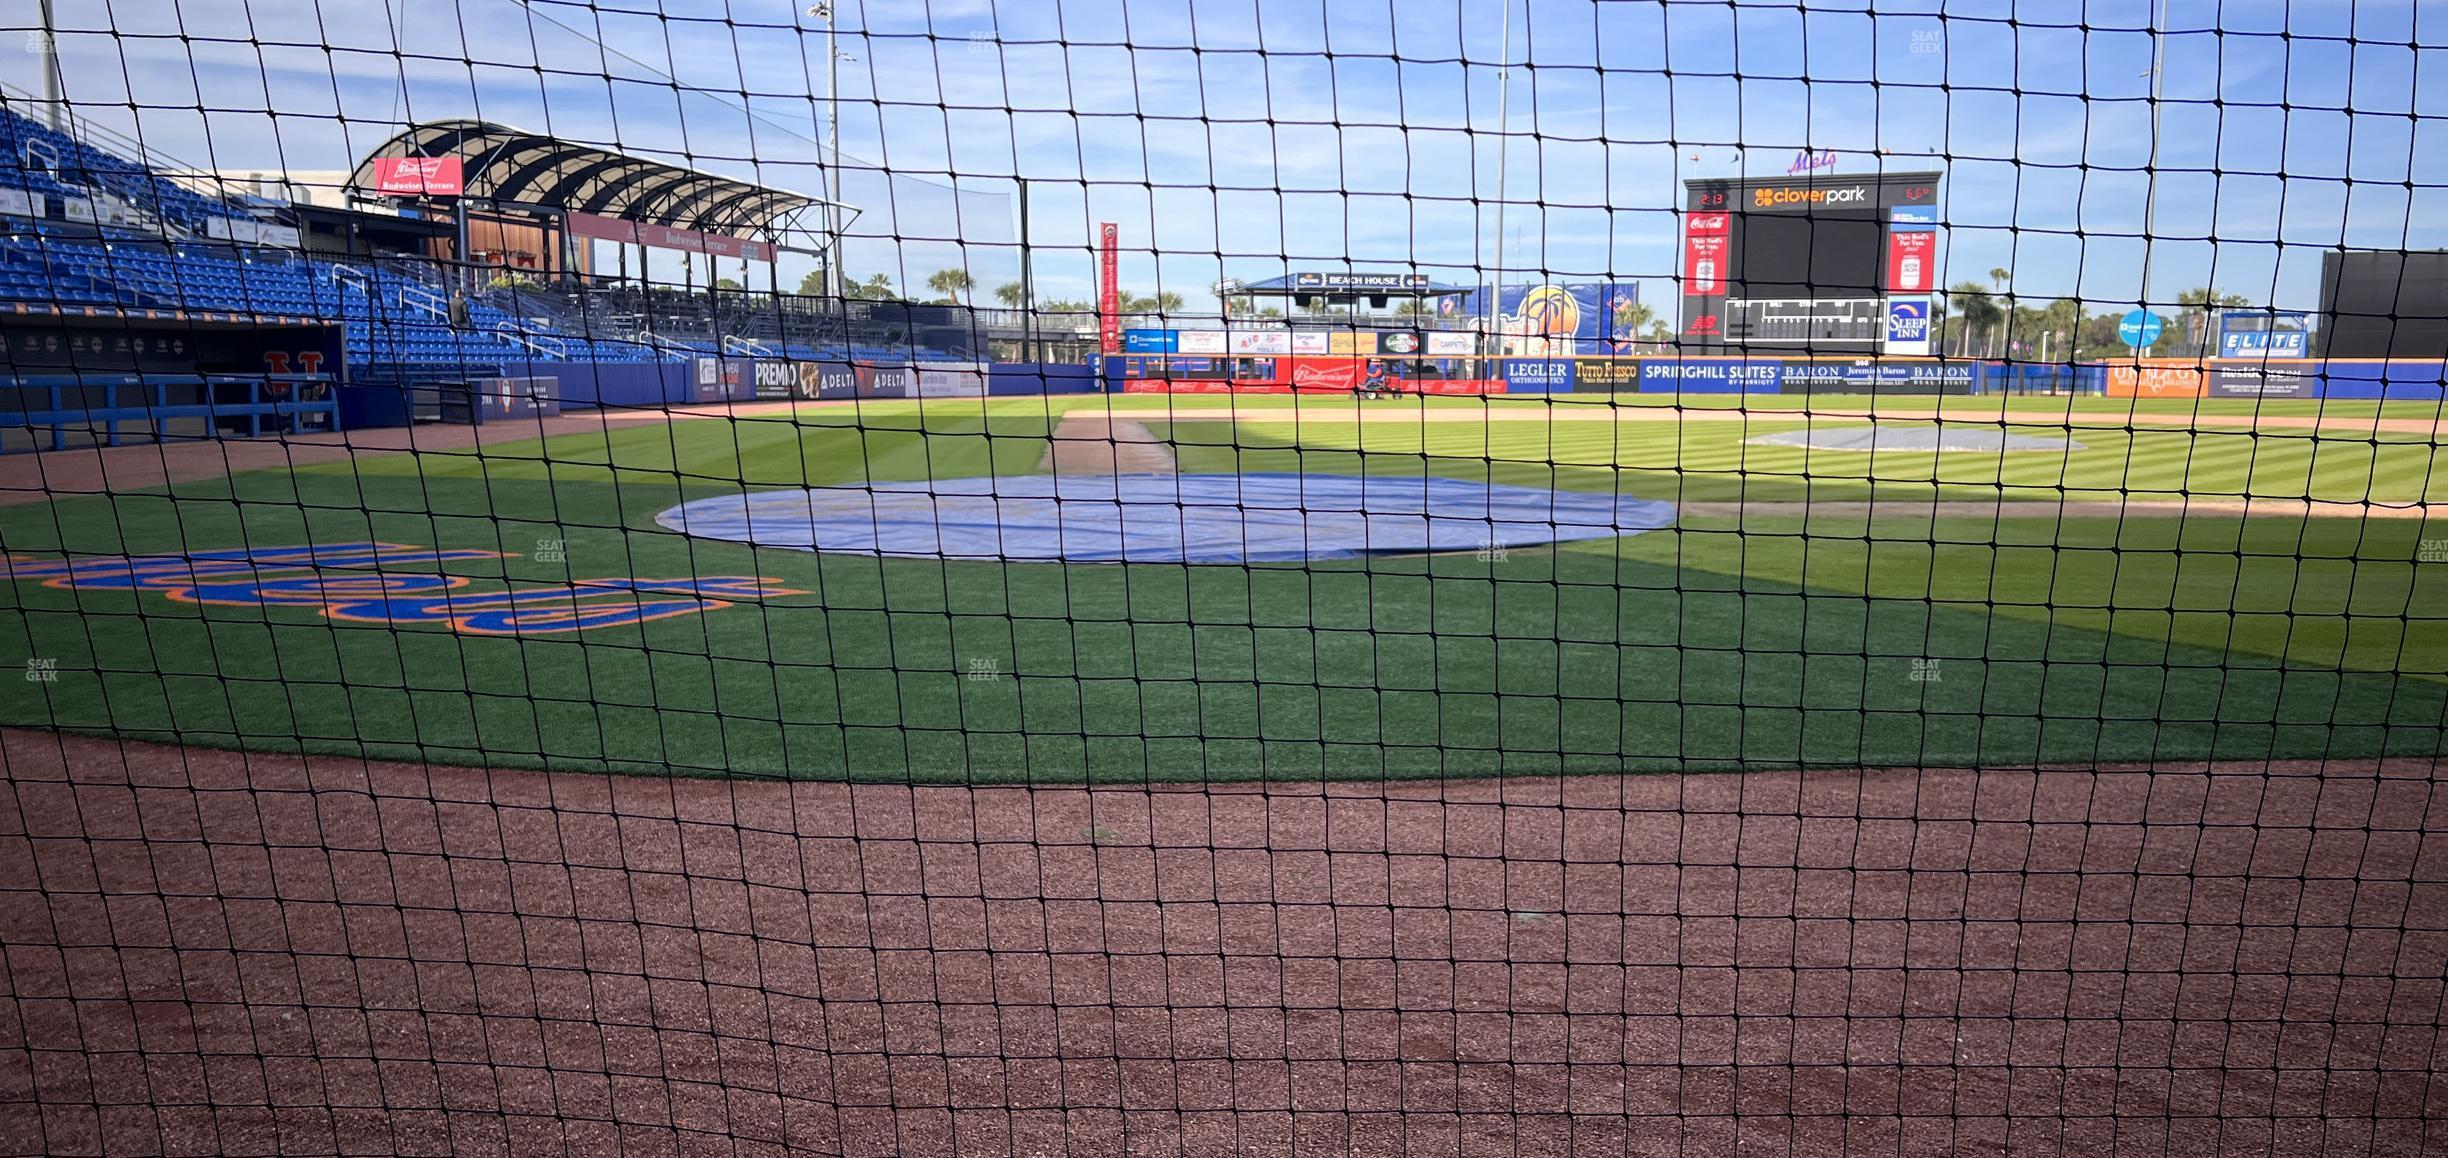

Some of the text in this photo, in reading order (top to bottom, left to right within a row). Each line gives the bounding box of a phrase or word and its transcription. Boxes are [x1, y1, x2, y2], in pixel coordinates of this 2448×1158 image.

[1787, 150, 1836, 175] Mets
[666, 231, 702, 247] Budweiser
[1329, 276, 1398, 285] BEACH HOUSE
[1889, 314, 1927, 332] SLEEP
[1897, 329, 1920, 338] INN
[2227, 333, 2300, 348] ELITE
[755, 362, 797, 387] PREMIO
[1509, 364, 1567, 376] LEGLER
[1728, 366, 1775, 378] SUITES
[1785, 366, 1839, 376] BARON
[1882, 366, 1906, 375] Baron
[1914, 366, 1968, 377] BARON
[829, 374, 855, 389] DELTA
[882, 374, 905, 387] DELTA
